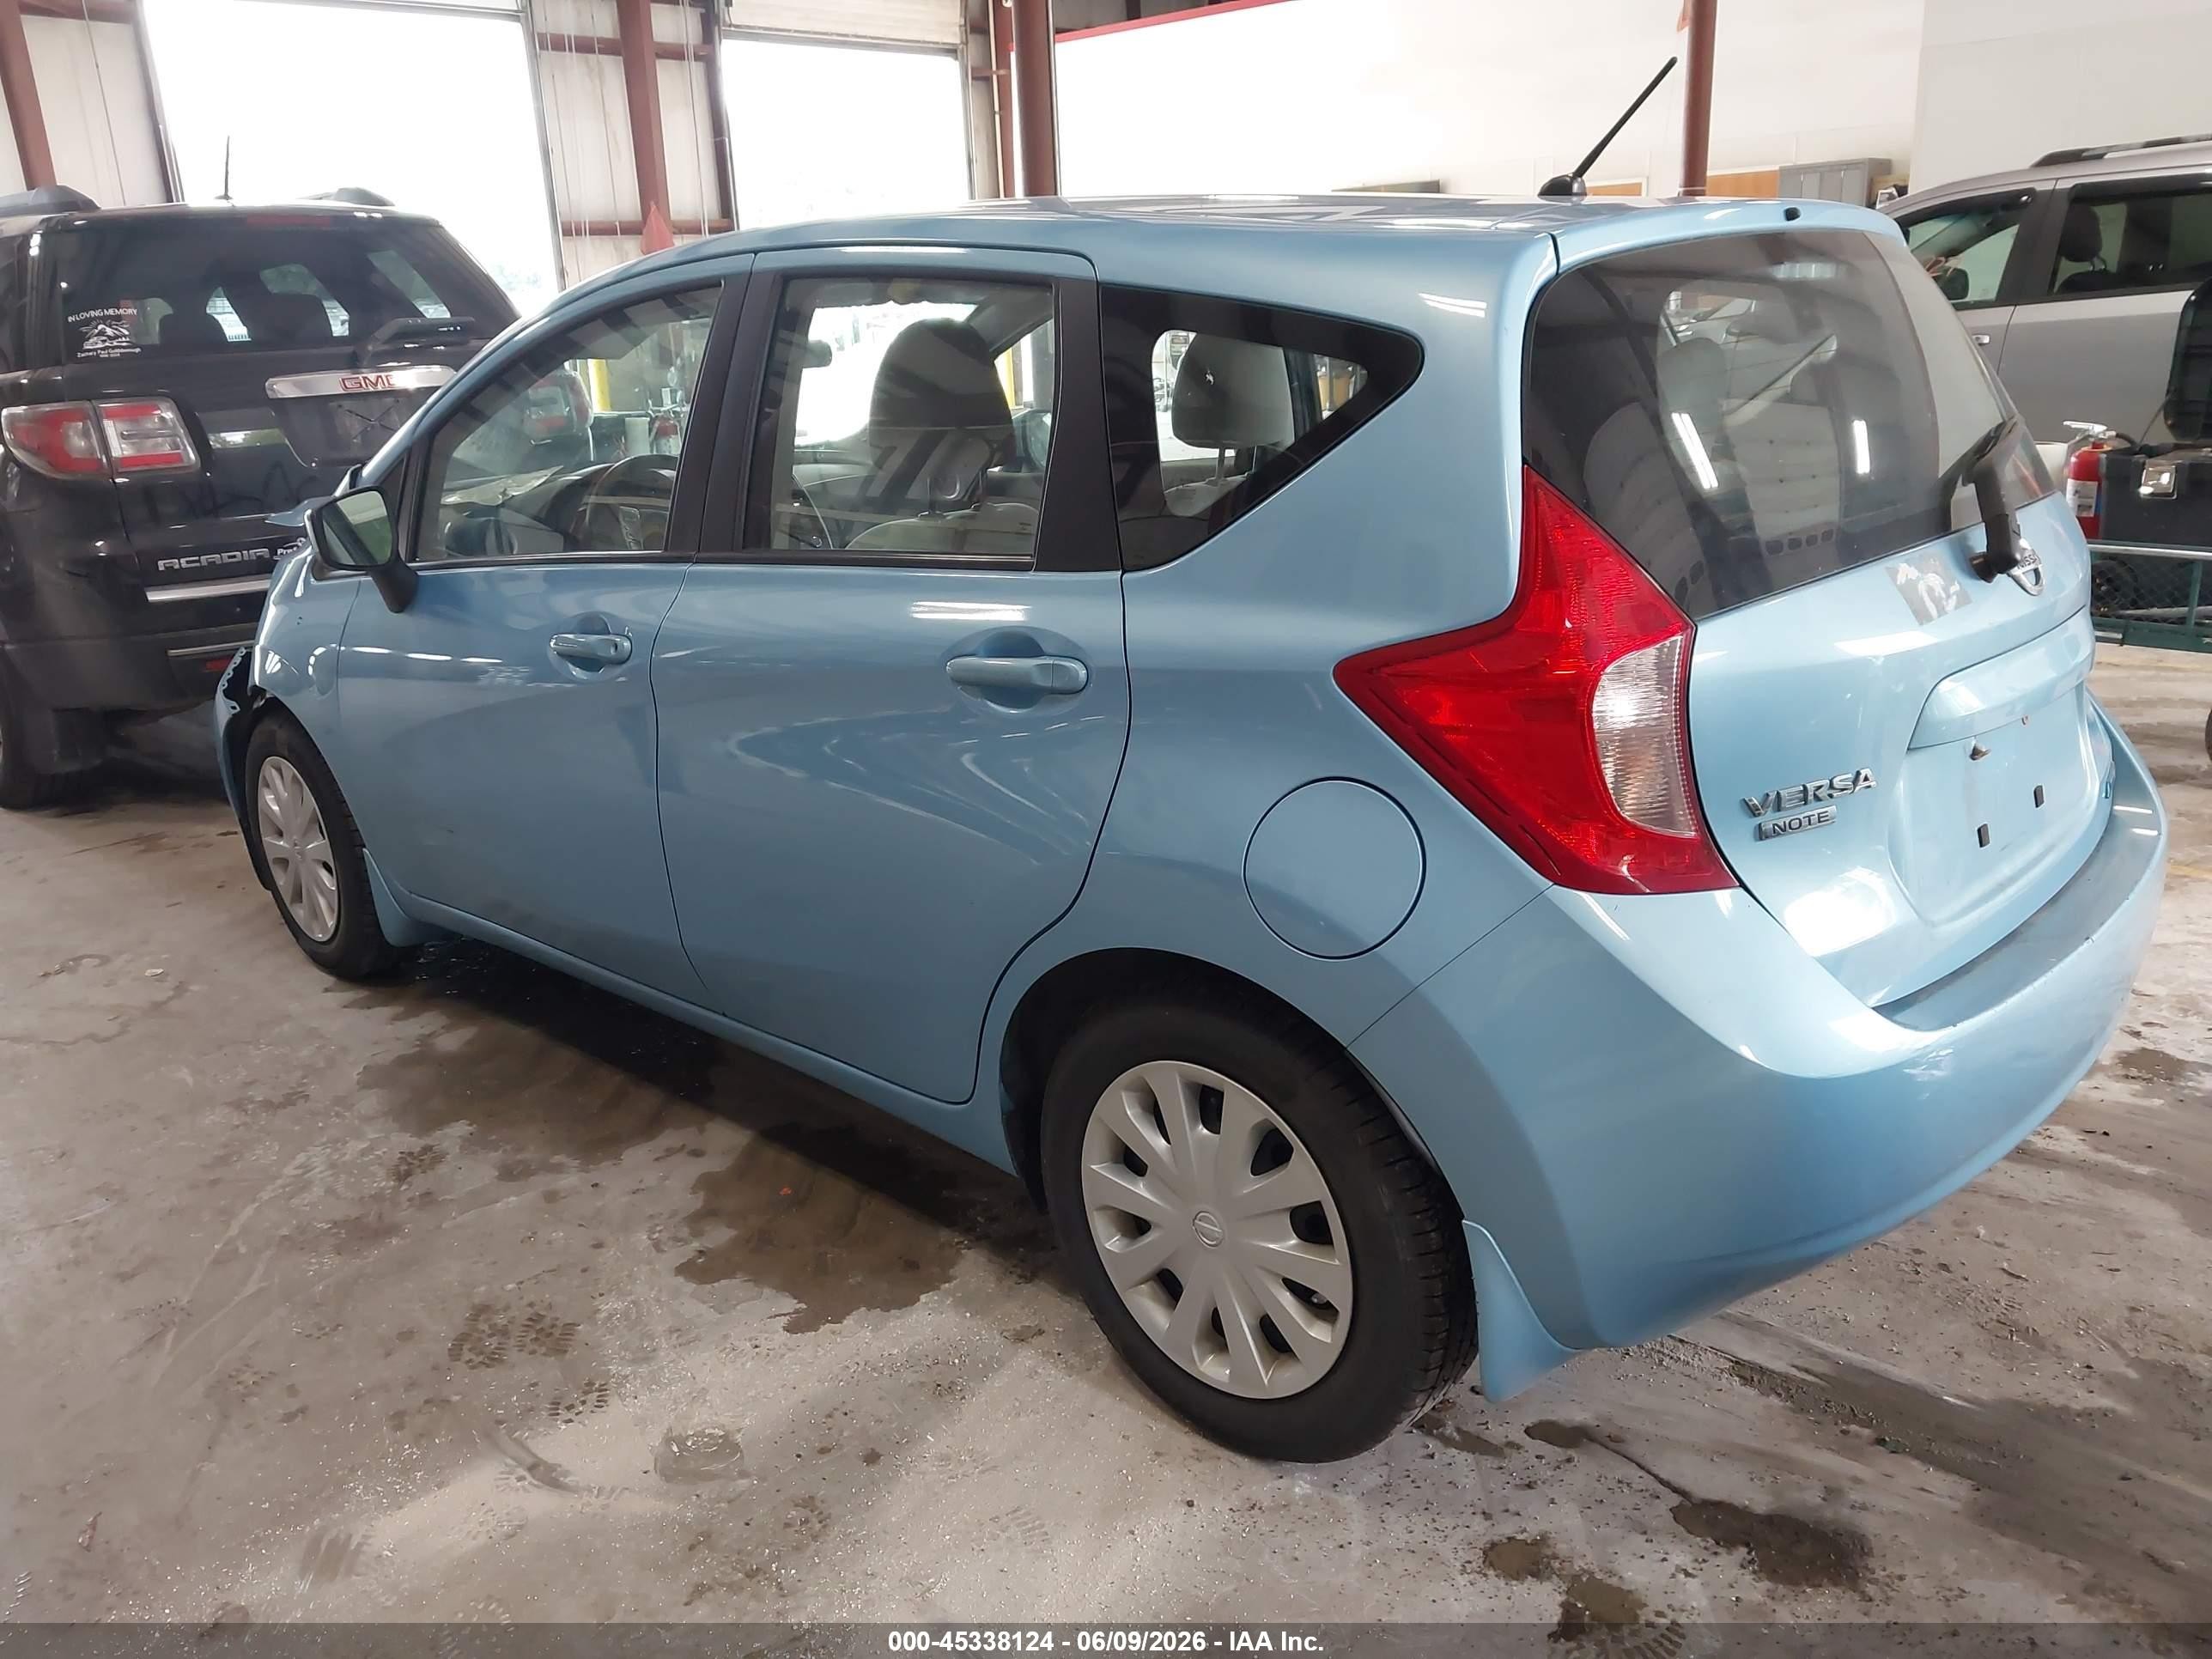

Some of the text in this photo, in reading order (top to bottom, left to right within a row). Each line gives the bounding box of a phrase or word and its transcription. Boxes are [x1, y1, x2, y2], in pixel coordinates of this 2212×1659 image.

[76, 309, 103, 320] LOVING
[157, 548, 270, 571] ACADIA
[1741, 768, 1877, 817] VERSA
[1771, 811, 1830, 835] NOTE
